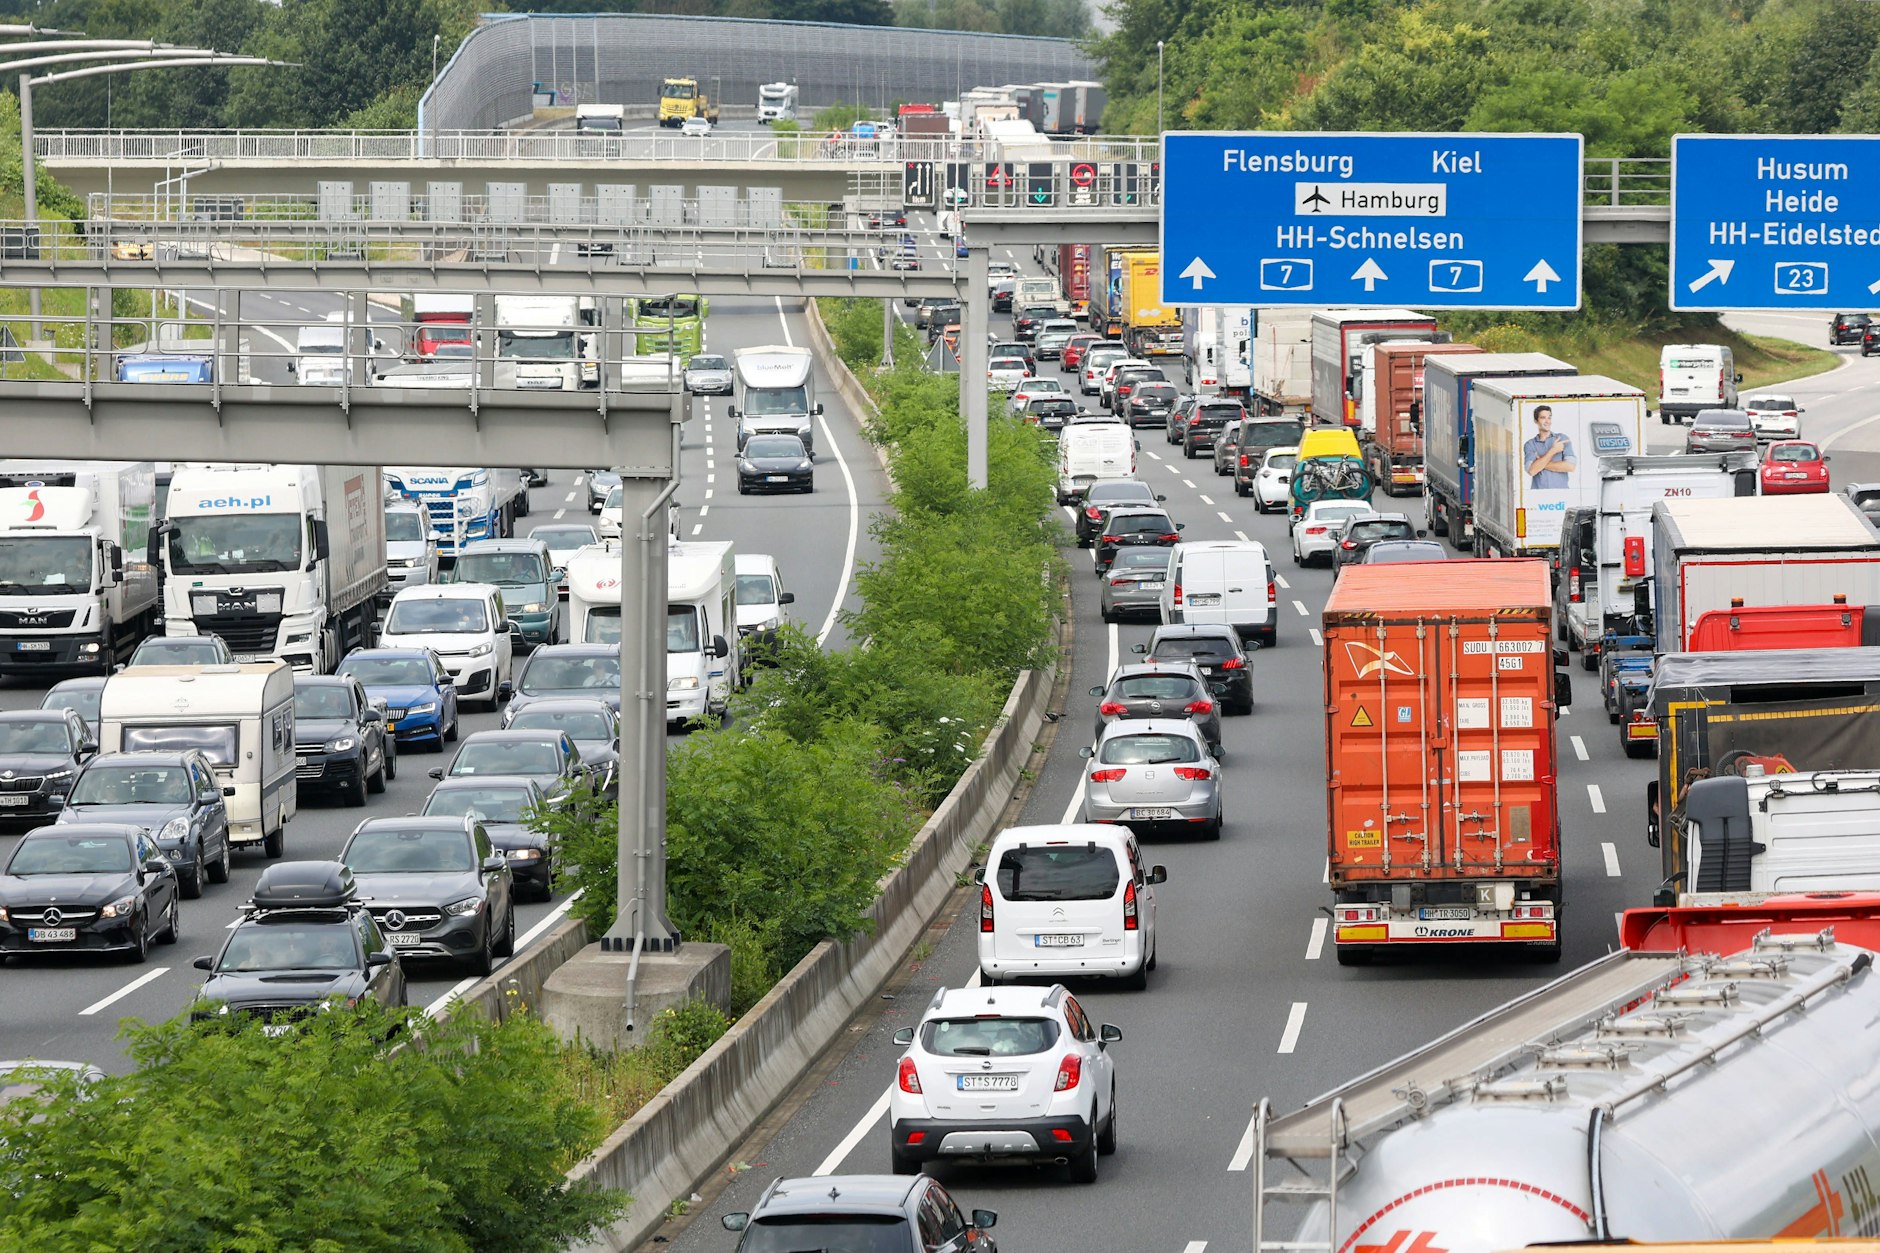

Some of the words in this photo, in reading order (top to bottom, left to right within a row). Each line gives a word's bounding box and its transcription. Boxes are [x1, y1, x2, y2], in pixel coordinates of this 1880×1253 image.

[1223, 149, 1353, 178] Flensburg
[1433, 150, 1482, 173] Kiel
[1757, 157, 1848, 180] Husum
[1342, 190, 1439, 214] Hamburg
[1765, 190, 1839, 212] Heide
[1277, 226, 1464, 249] HH-Schnelsen
[1281, 265, 1293, 284] 7
[1450, 267, 1462, 285] 7
[1789, 269, 1814, 288] 23
[1594, 424, 1620, 434] wedi
[1599, 438, 1629, 447] INSIDE
[410, 477, 449, 485] SCANIA
[1664, 488, 1691, 497] ZN10
[198, 495, 271, 508] aeh.pl
[1538, 501, 1565, 510] wedi
[217, 601, 256, 611] MAN
[1464, 642, 1487, 652] SUDU
[1499, 641, 1533, 652] 663002
[1539, 641, 1544, 652] 7
[1500, 658, 1521, 668] 45G1
[1480, 889, 1491, 901] K
[35, 930, 45, 938] DB
[48, 930, 57, 938] 43
[60, 930, 74, 938] 488
[1430, 929, 1474, 937] KRONE
